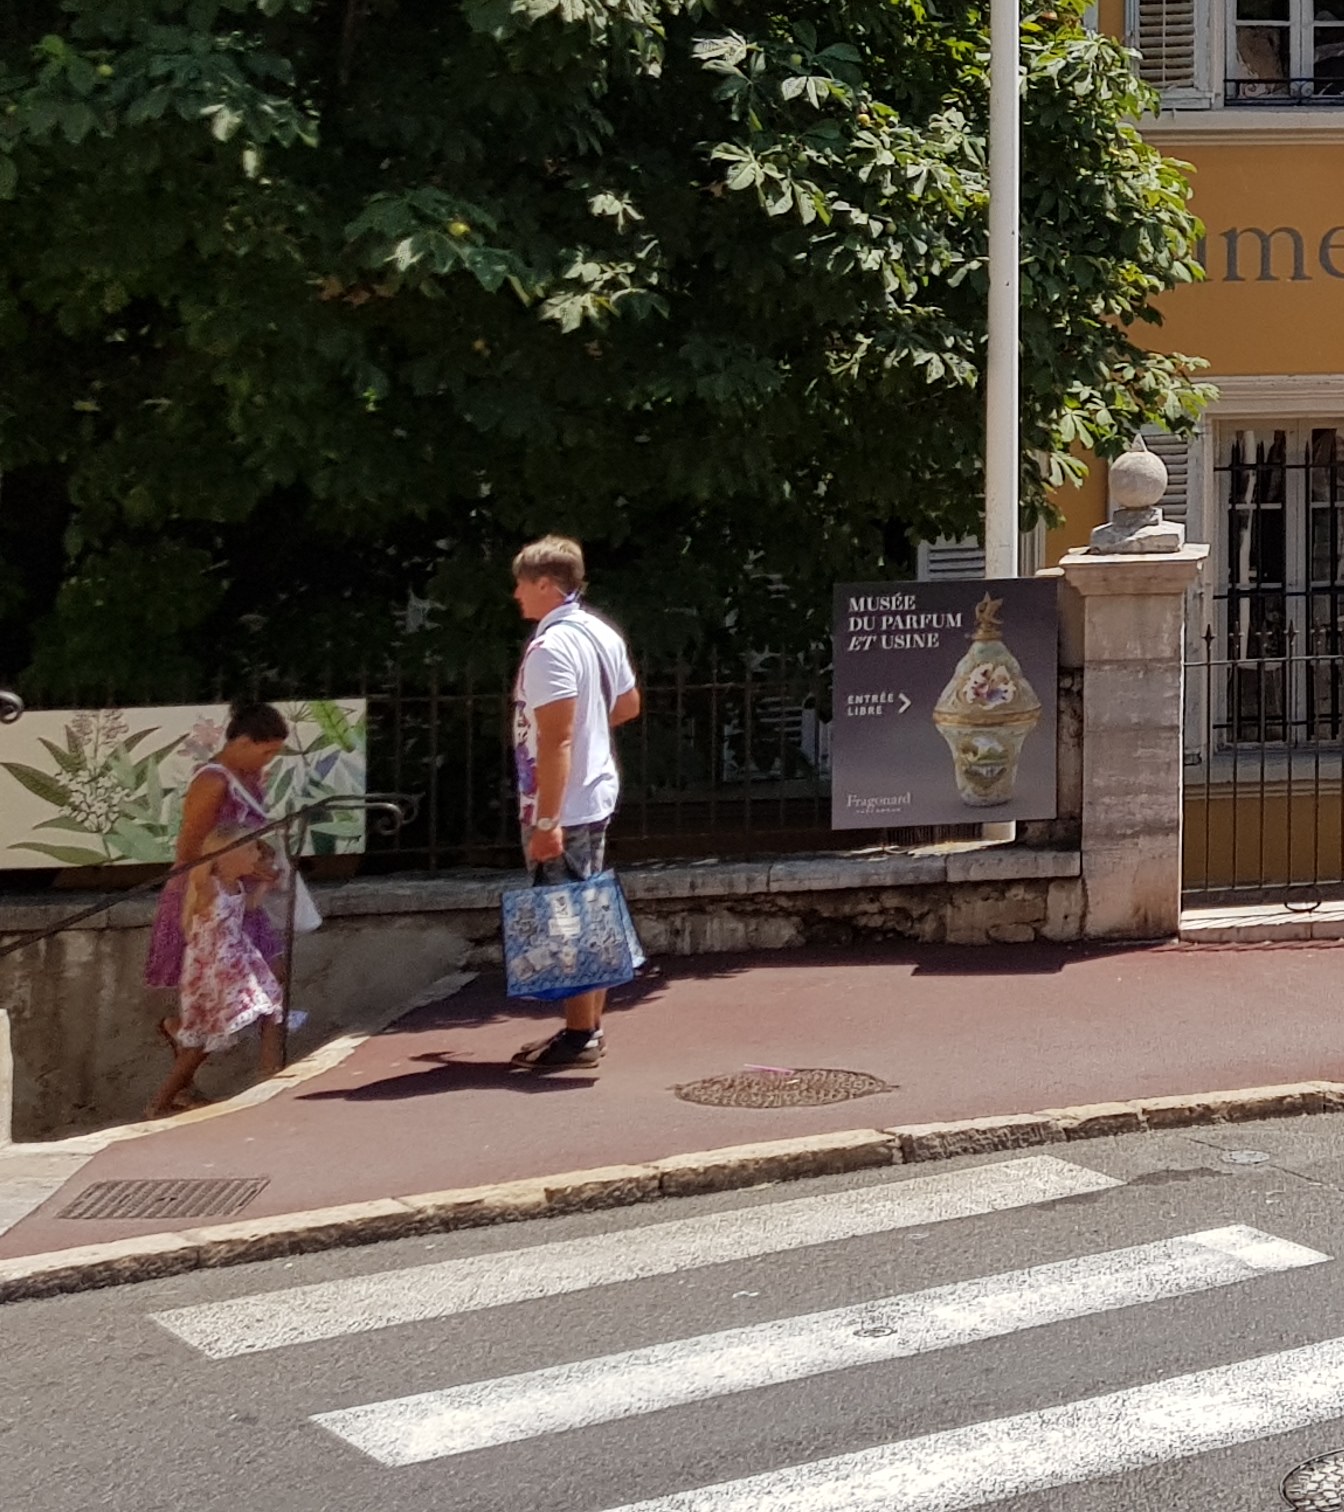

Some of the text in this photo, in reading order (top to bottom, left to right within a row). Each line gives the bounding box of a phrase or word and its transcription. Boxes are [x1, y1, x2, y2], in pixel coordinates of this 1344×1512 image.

[848, 592, 916, 612] MUSÉE
[848, 612, 962, 632] DU PARFUM
[847, 632, 940, 651] ET USINE
[847, 691, 894, 705] ENTRÉE
[847, 705, 883, 717] LIBRE
[846, 791, 912, 813] Fragonard
